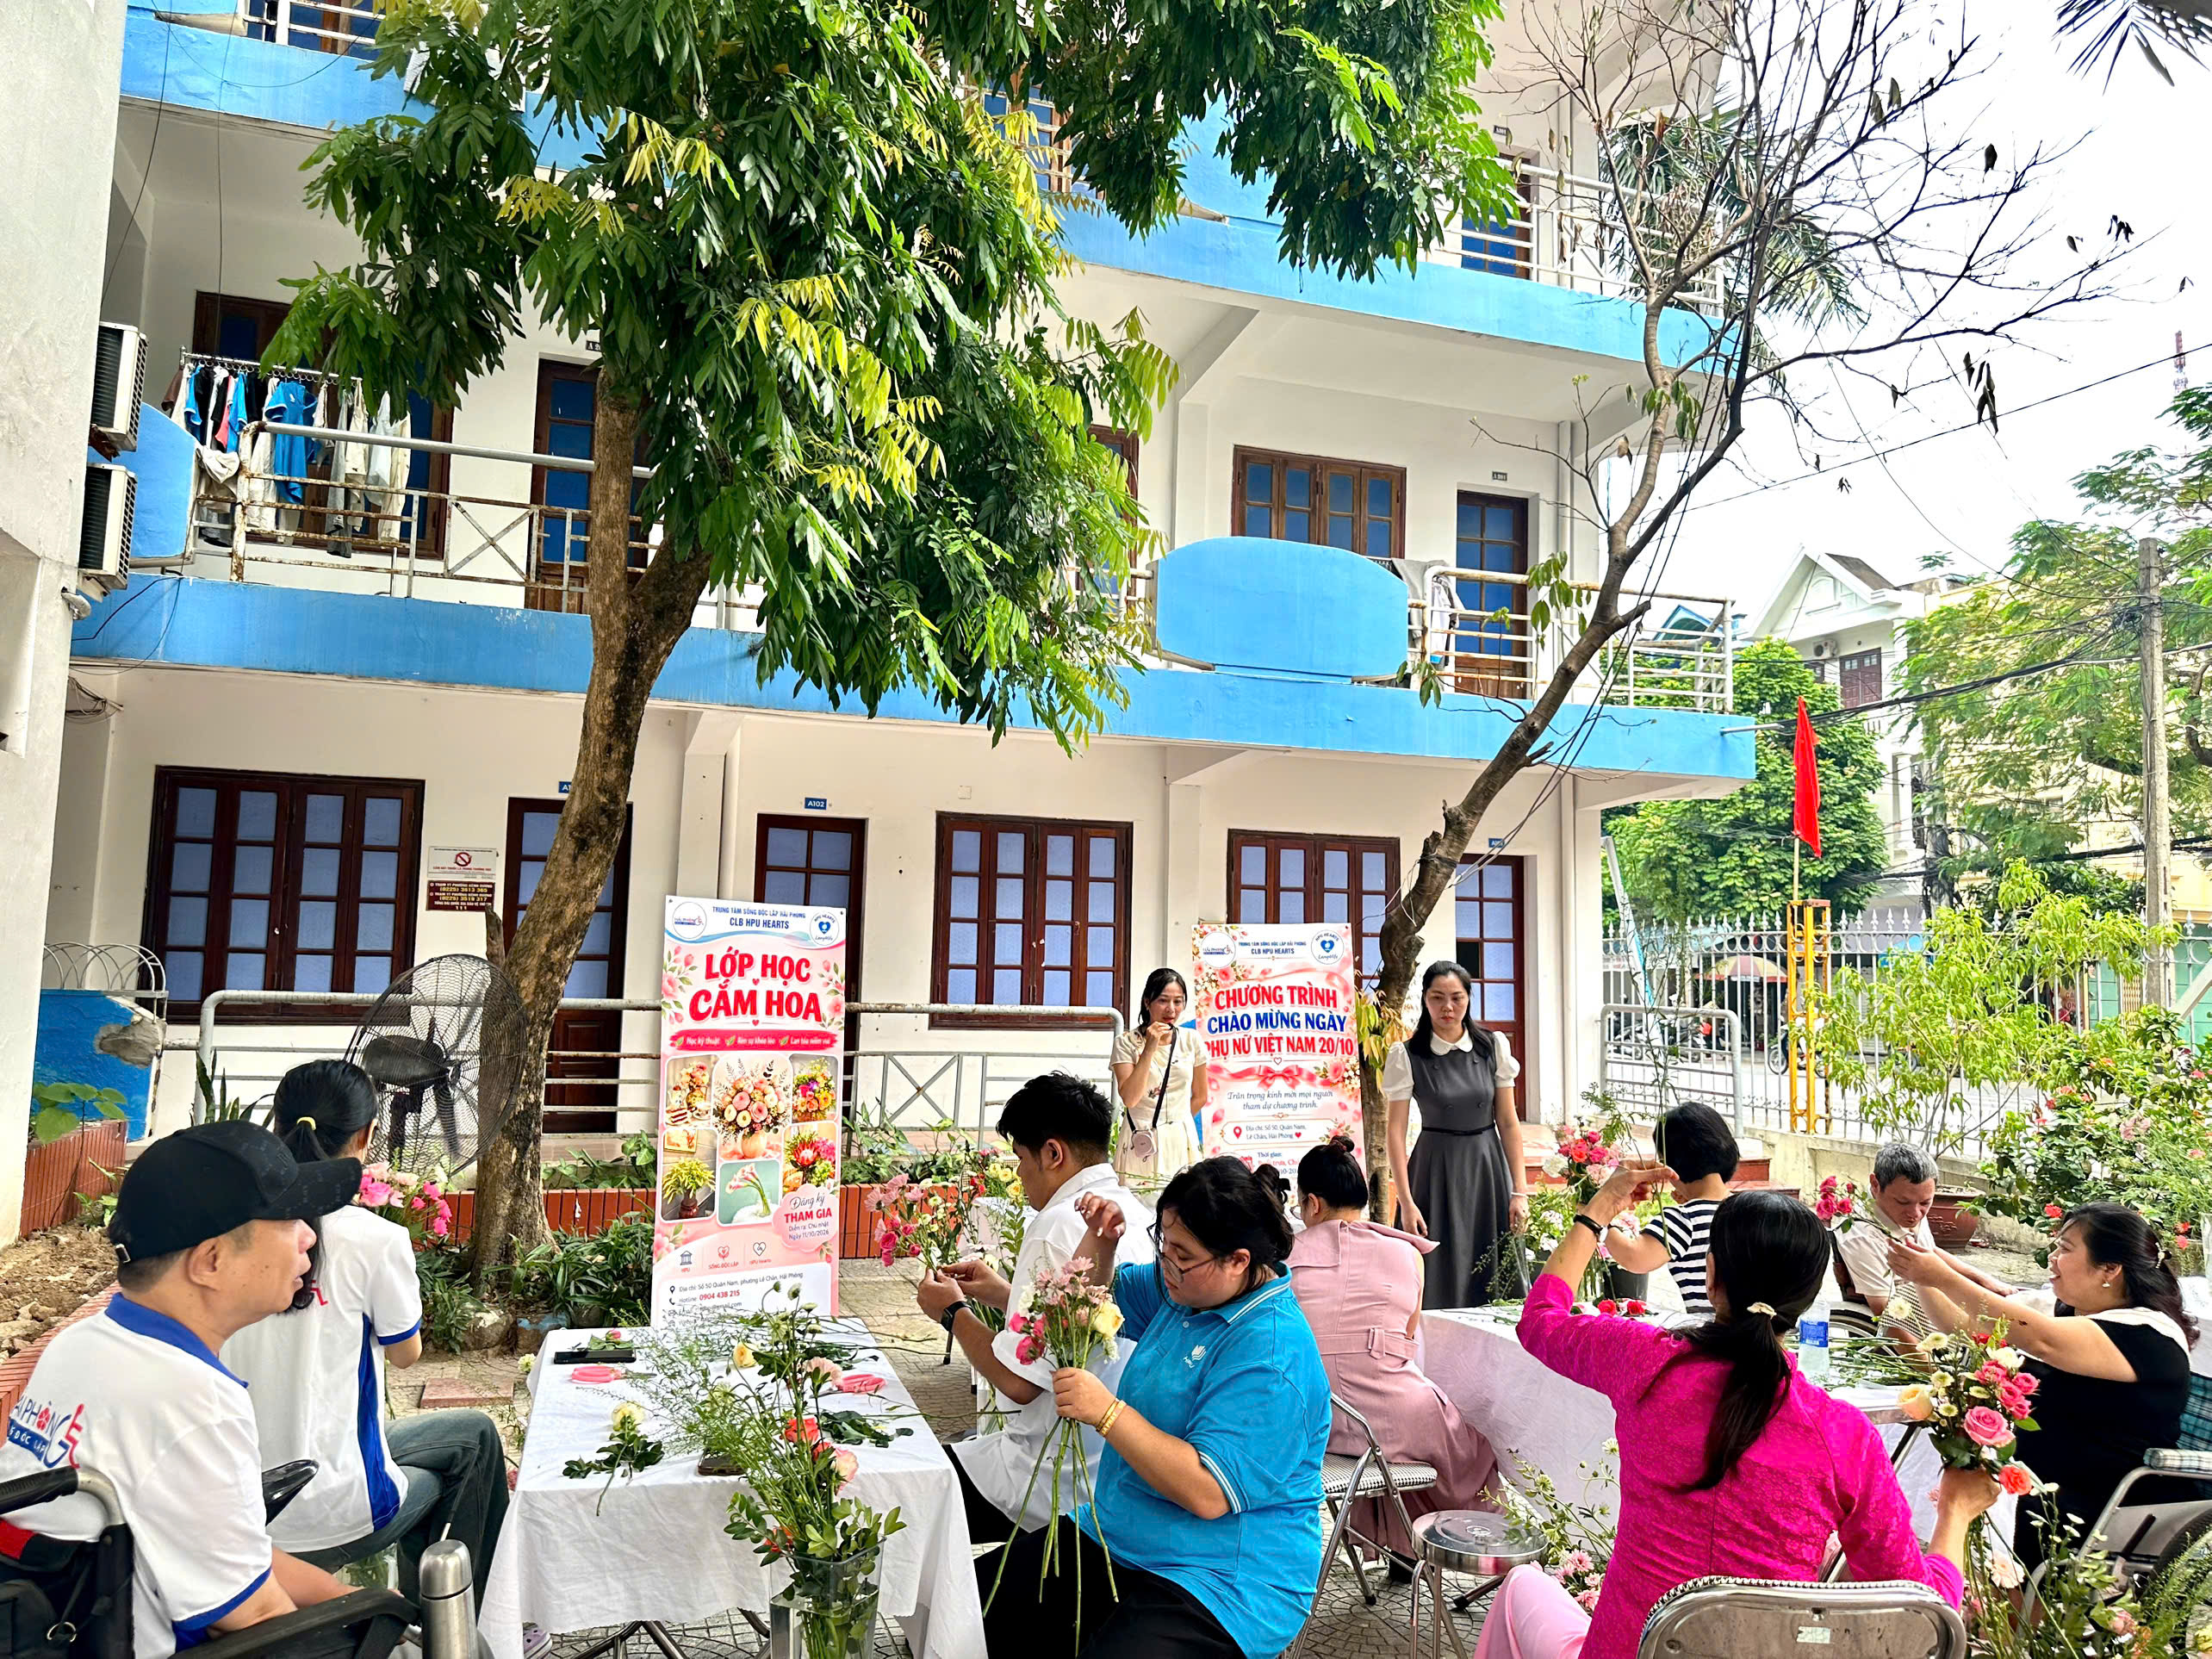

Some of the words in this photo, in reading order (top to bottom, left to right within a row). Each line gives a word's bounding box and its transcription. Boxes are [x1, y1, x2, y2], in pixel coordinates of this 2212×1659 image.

[730, 917, 743, 926] CLB
[746, 918, 760, 927] HPU
[762, 920, 789, 929] HEARTS
[705, 946, 754, 980] LỚP
[761, 954, 811, 986] HỌC
[689, 979, 758, 1021] CẮM
[765, 990, 822, 1022] HOA
[1215, 984, 1283, 1010] CHƯƠNG
[1287, 981, 1337, 1008] TRÌNH
[1207, 1011, 1252, 1034] CHÀO
[1256, 1009, 1300, 1030] MỪNG
[1305, 1011, 1347, 1032] NGÀY
[1233, 1035, 1252, 1054] NỮ
[1255, 1033, 1283, 1056] VIỆT
[1287, 1036, 1315, 1053] NAM
[1319, 1036, 1353, 1056] 20/10
[1247, 1092, 1265, 1101] trọng
[1313, 1090, 1333, 1100] người
[1262, 1102, 1272, 1110] dự
[1273, 1101, 1297, 1111] chương
[790, 1196, 814, 1210] Đăng
[816, 1192, 825, 1207] ký
[784, 1210, 813, 1223] THAM
[816, 1208, 832, 1219] GIA
